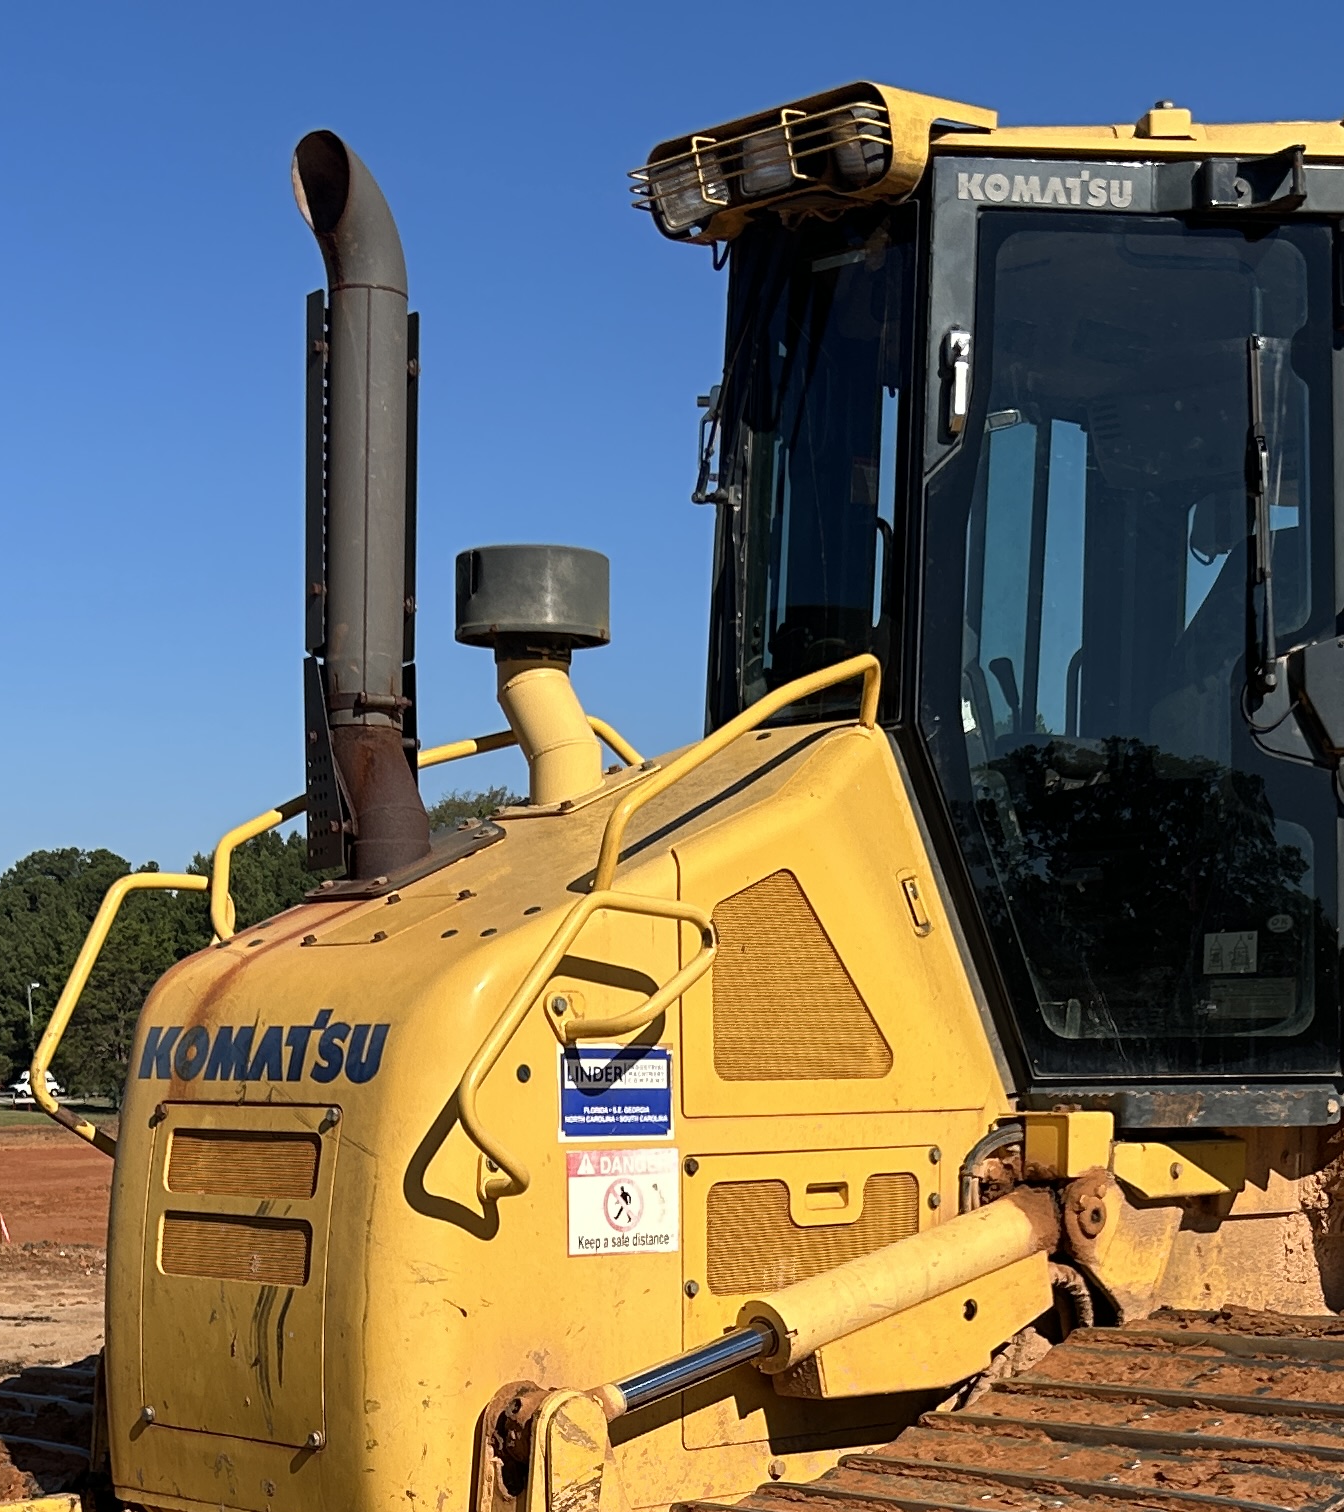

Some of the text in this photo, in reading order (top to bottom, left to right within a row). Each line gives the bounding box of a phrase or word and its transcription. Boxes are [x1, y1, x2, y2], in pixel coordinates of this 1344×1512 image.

[958, 170, 1133, 208] KOMATSU
[138, 1008, 391, 1084] KOMATSU
[567, 1065, 624, 1083] LINDER
[599, 1155, 667, 1175] DANG
[578, 1232, 670, 1252] Keep a safe distance
